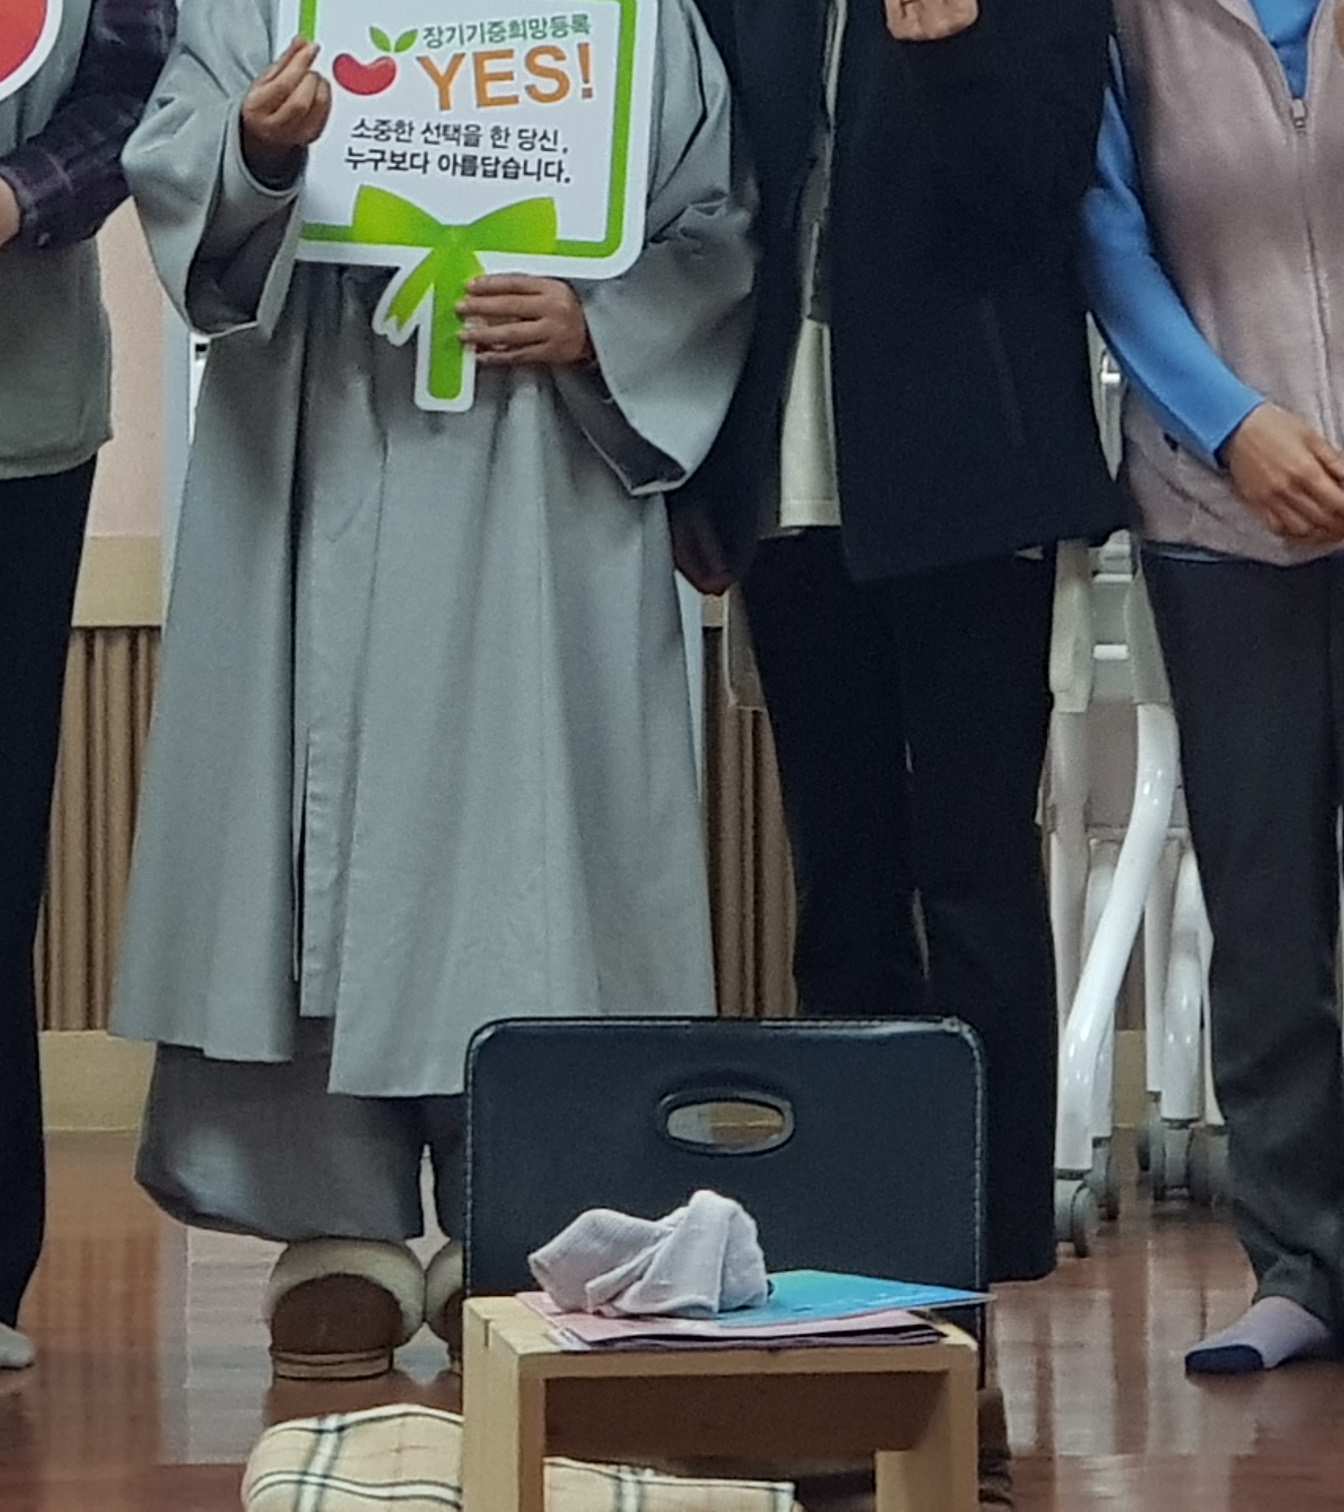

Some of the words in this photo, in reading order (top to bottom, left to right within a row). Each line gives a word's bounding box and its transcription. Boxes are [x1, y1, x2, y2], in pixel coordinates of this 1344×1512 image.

[423, 13, 592, 49] 장기기증희망등록
[415, 42, 594, 111] YES!
[351, 117, 415, 144] 소중한
[421, 121, 483, 148] 선택을
[490, 125, 511, 150] 한
[517, 128, 569, 155] 당신,
[344, 146, 431, 175] 누구보다
[437, 153, 571, 184] 아름답습니다.
